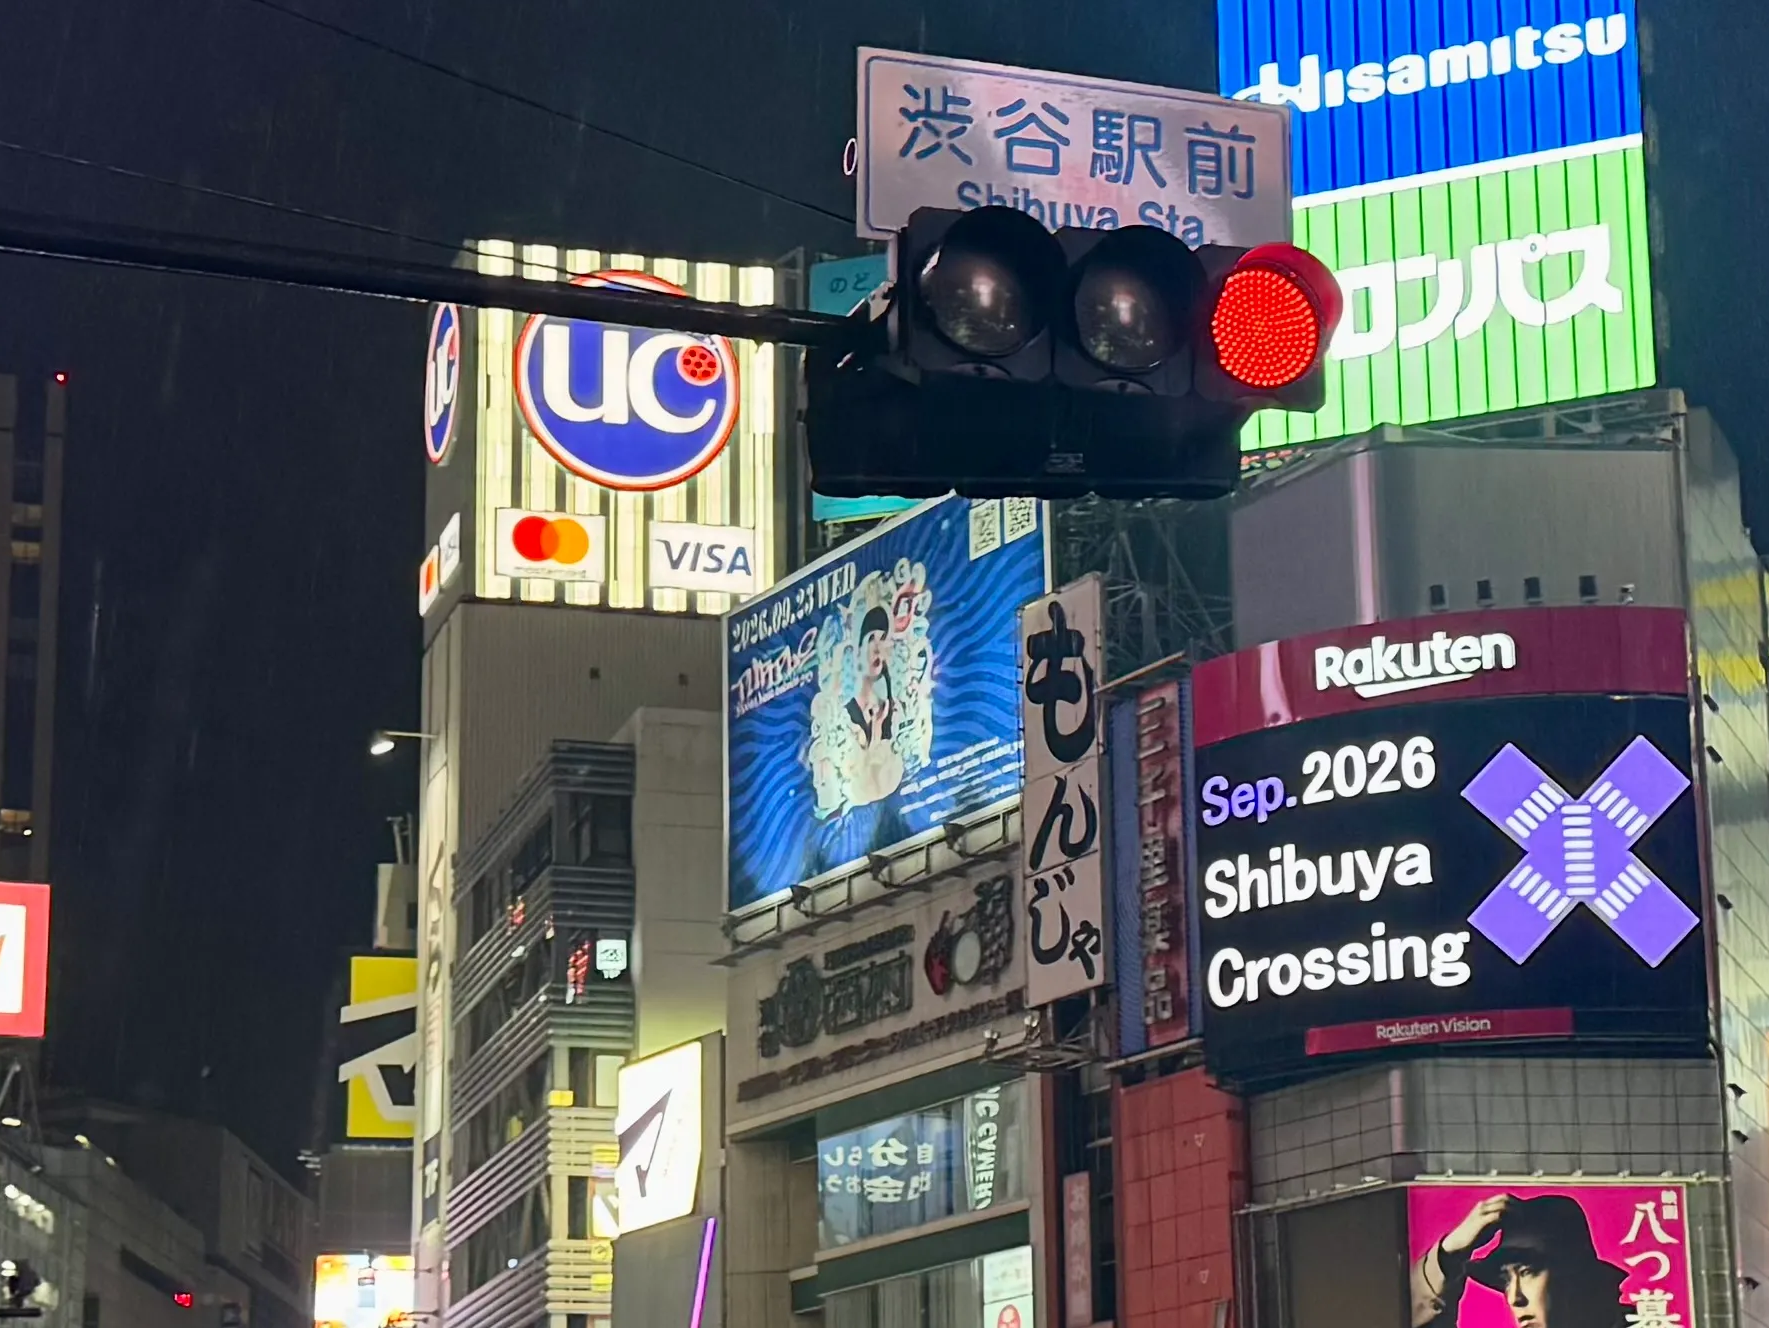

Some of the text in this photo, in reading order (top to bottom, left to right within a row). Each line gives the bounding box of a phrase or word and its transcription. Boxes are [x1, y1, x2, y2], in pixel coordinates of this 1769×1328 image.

[1231, 12, 1628, 113] Hisamitsu
[899, 83, 1256, 200] 渋谷駅前
[654, 537, 753, 578] VISA
[817, 561, 857, 609] WED
[1314, 630, 1518, 696] Rakuten
[1025, 599, 1102, 980] もんじゃ
[1203, 841, 1433, 921] Shibuya
[1206, 921, 1472, 1009] Crossing
[1375, 1014, 1491, 1041] Rakuten Vision
